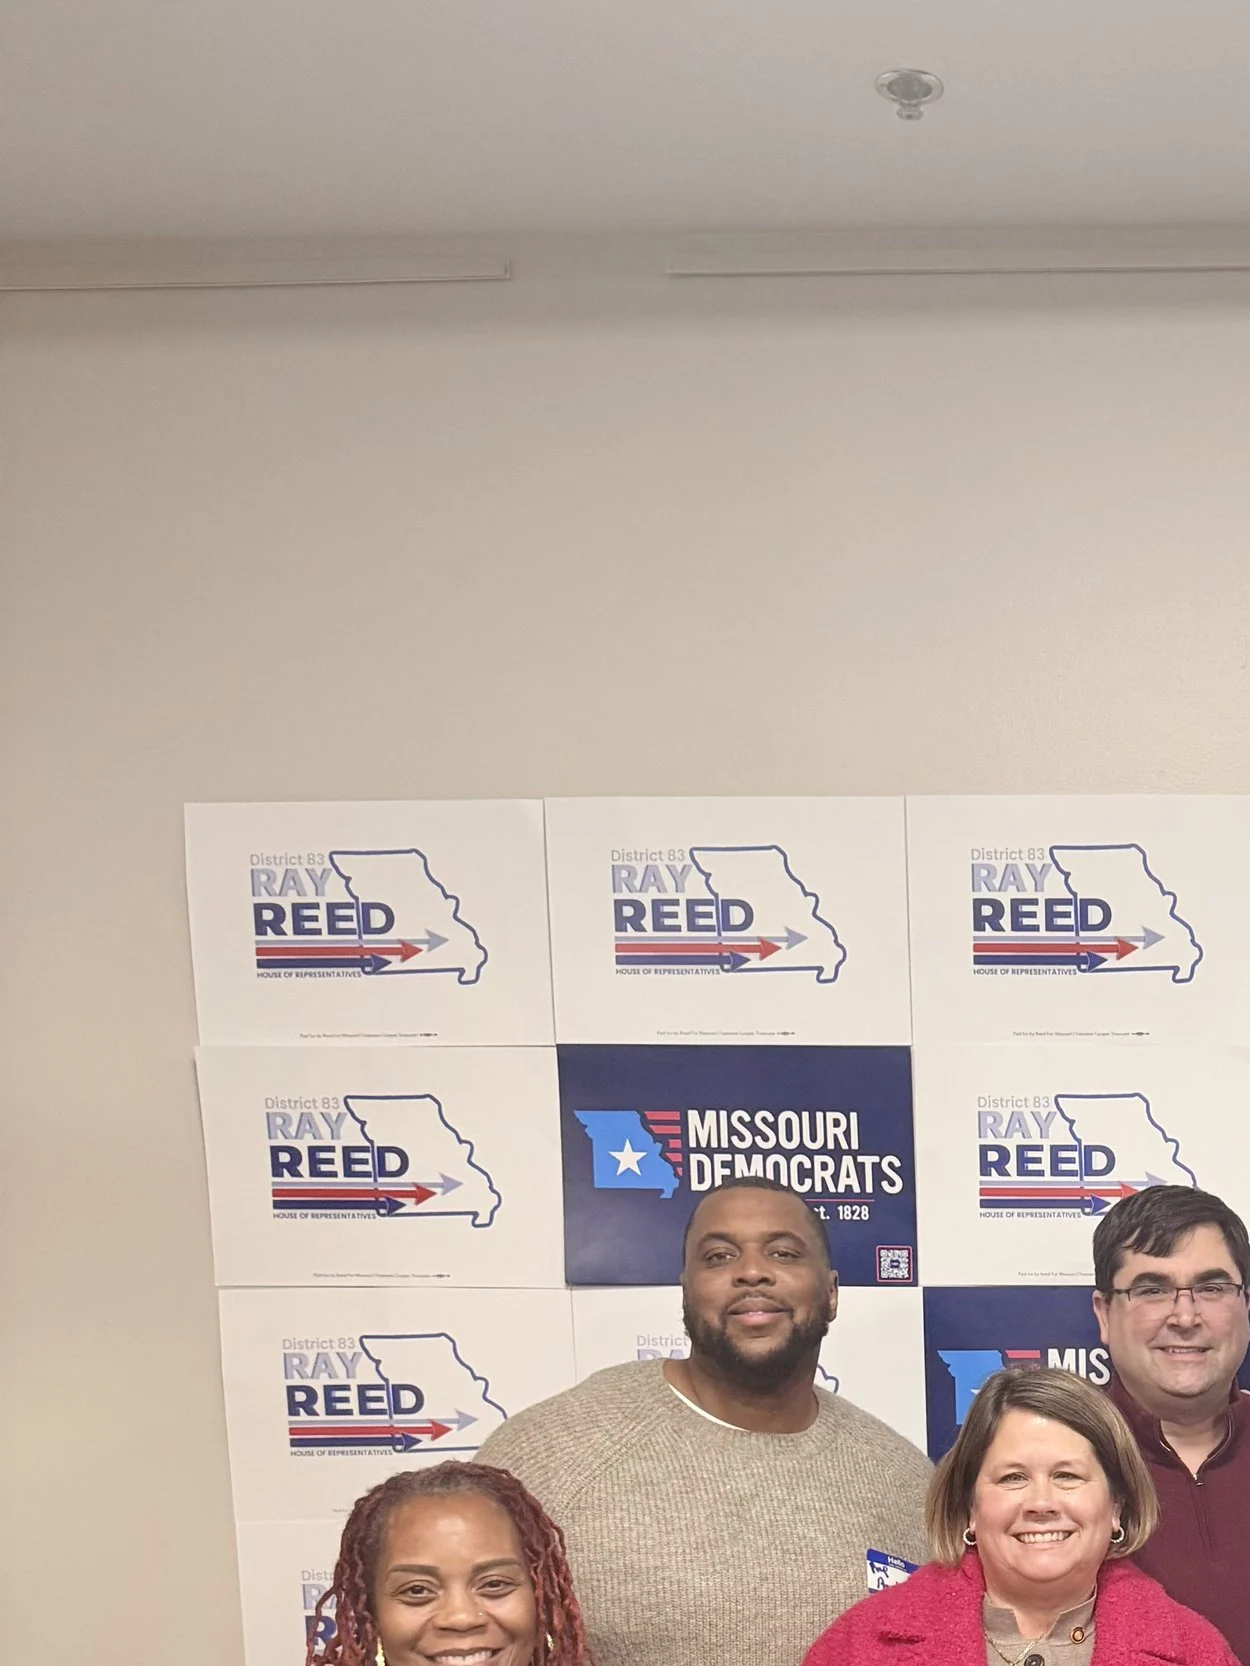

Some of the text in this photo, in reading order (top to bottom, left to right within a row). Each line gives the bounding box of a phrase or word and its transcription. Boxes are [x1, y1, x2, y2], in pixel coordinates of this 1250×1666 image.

[250, 853, 324, 866] District 83
[611, 849, 685, 862] District 83
[971, 848, 1044, 861] District 83
[251, 868, 333, 896] RAY
[612, 864, 693, 893] RAY
[971, 863, 1052, 892] RAY
[253, 902, 395, 935] REED
[614, 899, 754, 932] REED
[973, 898, 1112, 932] REED
[265, 1097, 339, 1109] District 83
[978, 1096, 1050, 1108] District 83
[266, 1111, 348, 1140] RAY
[687, 1110, 859, 1150] MISSOURI
[978, 1111, 1057, 1138] RAY
[270, 1145, 409, 1178] REED
[690, 1153, 903, 1194] DEMOCRATS
[979, 1144, 1116, 1176] REED
[838, 1205, 869, 1220] 1828
[282, 1337, 355, 1349] District 83
[637, 1334, 688, 1346] District
[283, 1352, 362, 1379] RAY
[286, 1384, 425, 1416] REED
